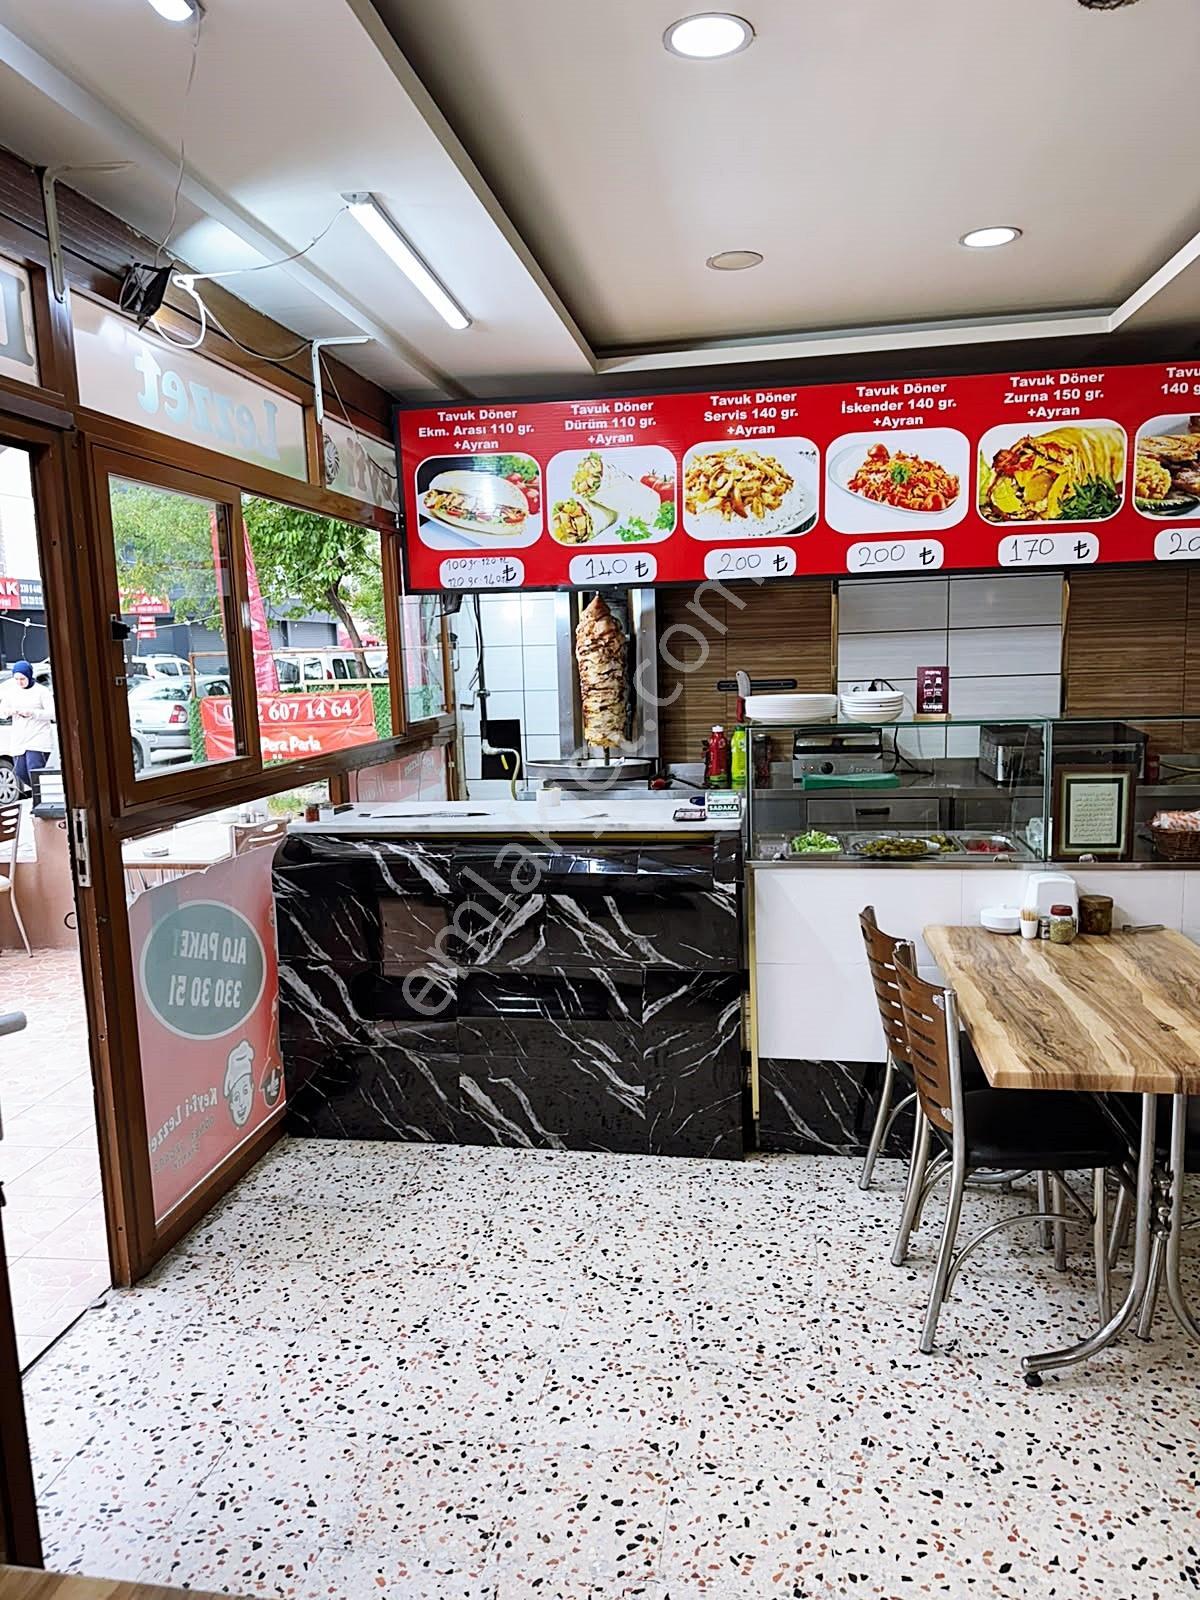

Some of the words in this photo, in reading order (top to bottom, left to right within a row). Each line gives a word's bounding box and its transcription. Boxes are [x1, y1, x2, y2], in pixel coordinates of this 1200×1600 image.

[1010, 375, 1054, 388] Tavuk
[1060, 373, 1104, 385] Döner
[856, 384, 899, 398] Tavuk
[904, 383, 947, 395] Döner
[1161, 382, 1189, 395] 140
[710, 393, 752, 406] Tavuk
[755, 392, 797, 404] Döner
[1004, 392, 1048, 404] Zurna
[1053, 389, 1080, 401] 150
[1085, 389, 1104, 402] gr.
[571, 403, 610, 416] Tavuk
[614, 402, 654, 413] Döner
[841, 400, 903, 414] İskender
[908, 398, 934, 410] 140
[938, 398, 957, 411] gr.
[1028, 406, 1080, 420] +Ayran
[437, 410, 475, 422] Tavuk
[479, 409, 518, 420] Döner
[704, 410, 747, 422] Servis
[752, 407, 777, 419] 140
[781, 408, 799, 420] gr.
[565, 420, 608, 431] Dürüm
[612, 416, 636, 428] 110
[640, 417, 657, 429] gr.
[873, 416, 923, 429] +Ayran
[418, 427, 450, 438] Ekm.
[453, 425, 486, 436] Arası
[490, 423, 514, 434] 110
[517, 424, 535, 436] gr.
[727, 424, 775, 438] +Ayran
[453, 440, 499, 452] +Ayran
[587, 433, 634, 446] +Ayran
[858, 544, 905, 567] 200
[918, 546, 936, 566] ₺
[1009, 538, 1055, 562] 170
[1073, 540, 1090, 559] ₺
[634, 560, 649, 578] ₺
[717, 553, 761, 574] 200
[772, 554, 788, 573] ₺
[268, 701, 299, 721] 607
[305, 700, 326, 720] 14
[330, 699, 353, 718] 64
